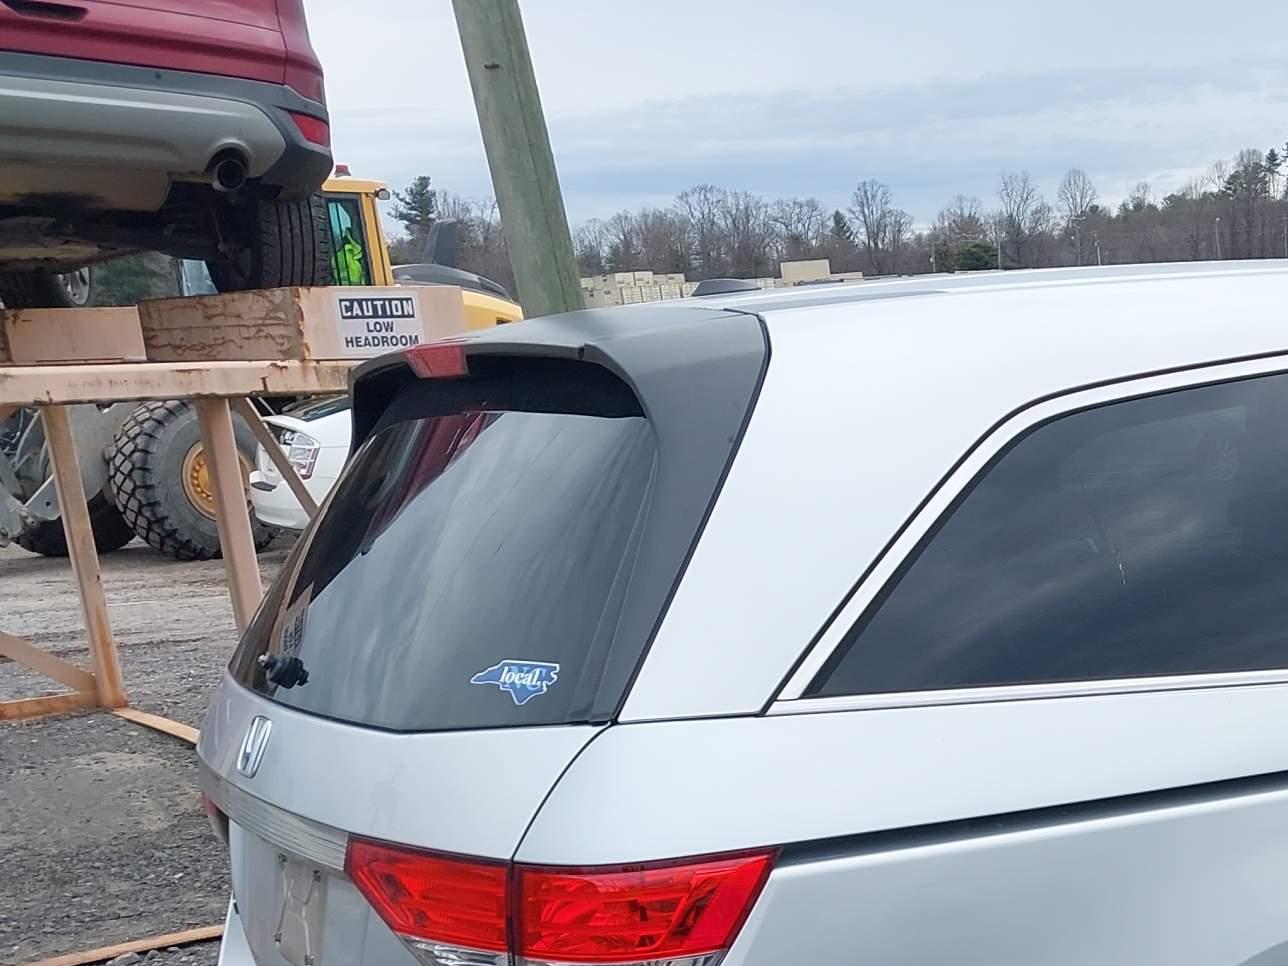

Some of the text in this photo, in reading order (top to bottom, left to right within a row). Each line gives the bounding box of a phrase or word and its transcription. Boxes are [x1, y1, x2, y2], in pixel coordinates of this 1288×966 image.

[340, 300, 414, 317] CAUTION
[366, 321, 394, 333] LOW
[344, 335, 419, 348] HEADROOM
